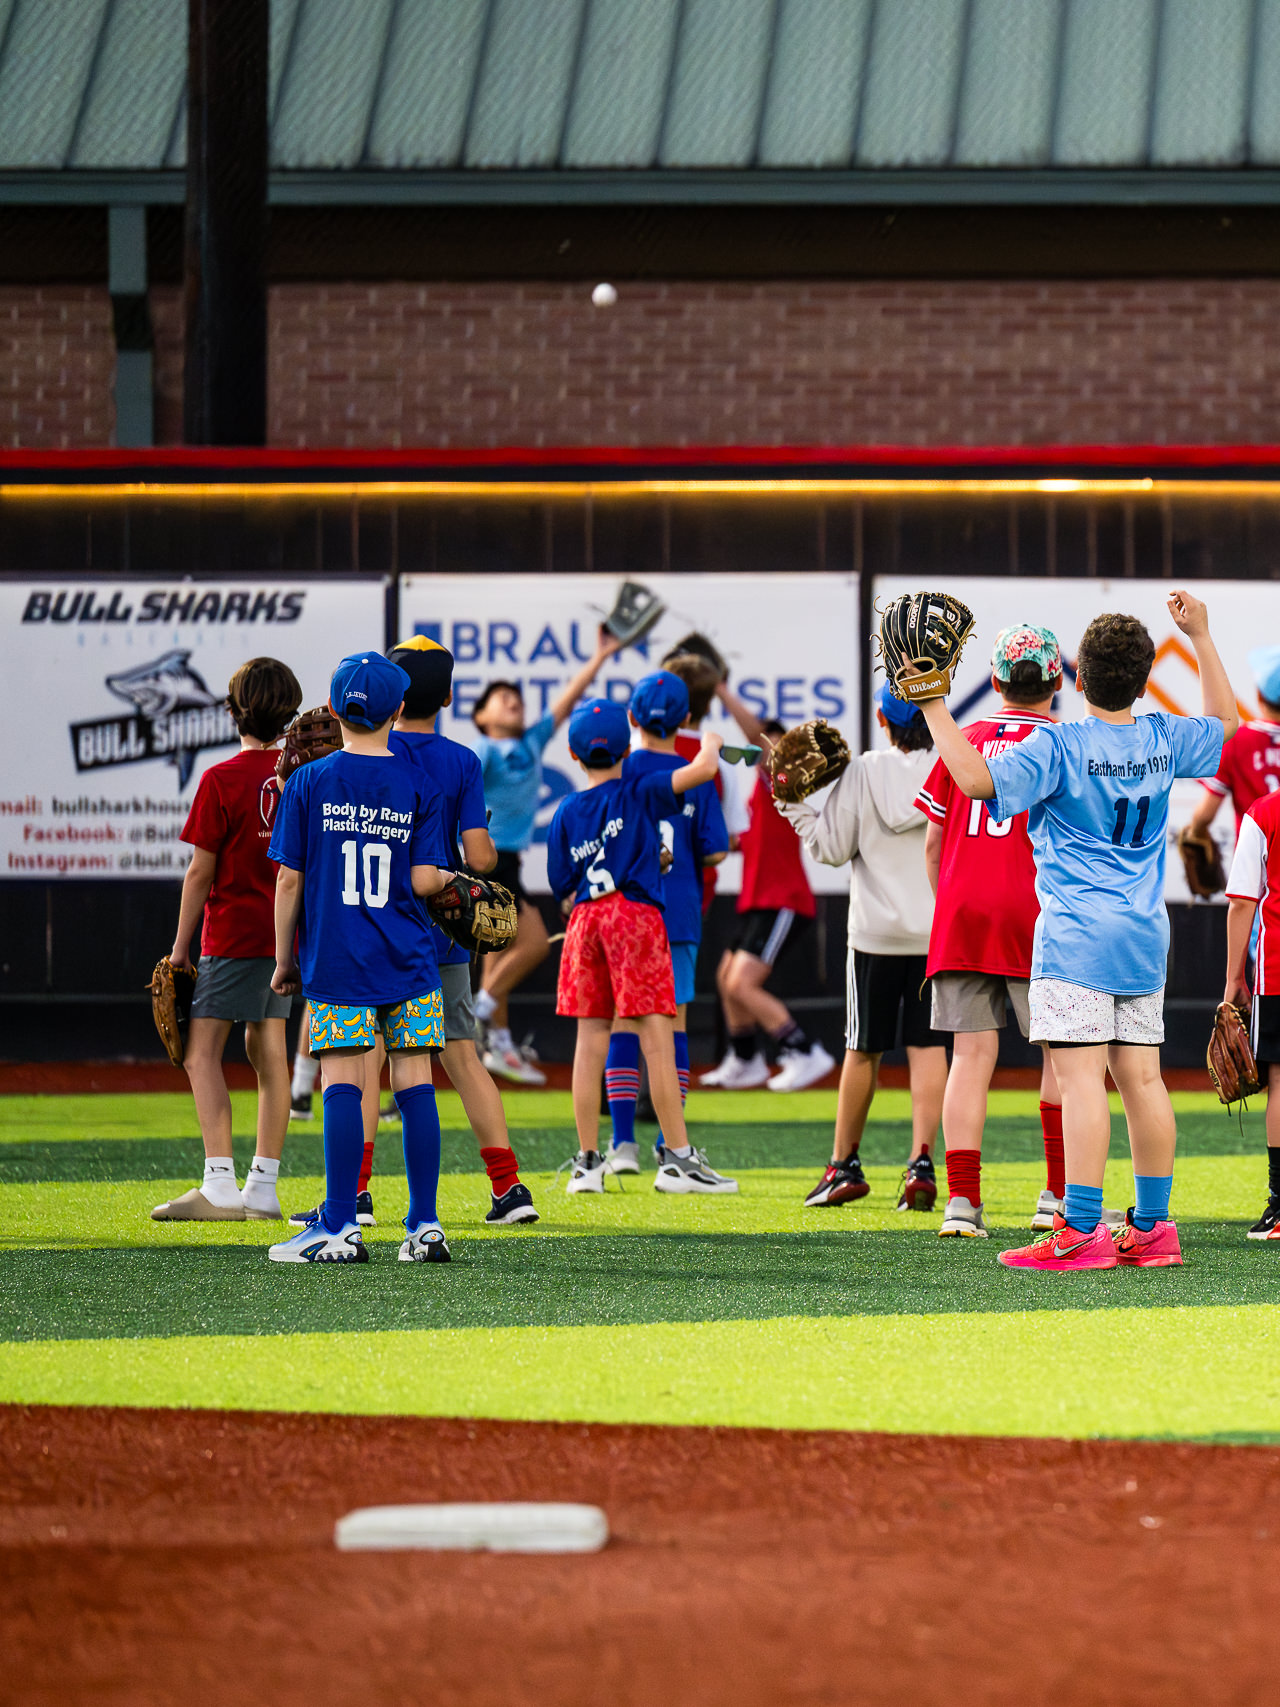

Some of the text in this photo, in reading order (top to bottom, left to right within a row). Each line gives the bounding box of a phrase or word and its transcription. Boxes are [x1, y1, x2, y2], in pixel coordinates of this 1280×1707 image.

[22, 590, 307, 624] BULL SHARKS
[909, 679, 942, 694] Wilson
[78, 707, 239, 766] BULL SHARK
[1088, 760, 1126, 777] Eastham
[1148, 755, 1168, 774] 1913
[0, 795, 42, 815] mail:
[322, 803, 413, 825] Body by Ravi
[22, 823, 124, 842] Facebook:
[322, 819, 411, 843] Plastic Surgery
[1112, 796, 1150, 848] 11
[8, 852, 114, 871] Instagram:
[570, 839, 602, 863] Swiss
[342, 840, 392, 908] 10
